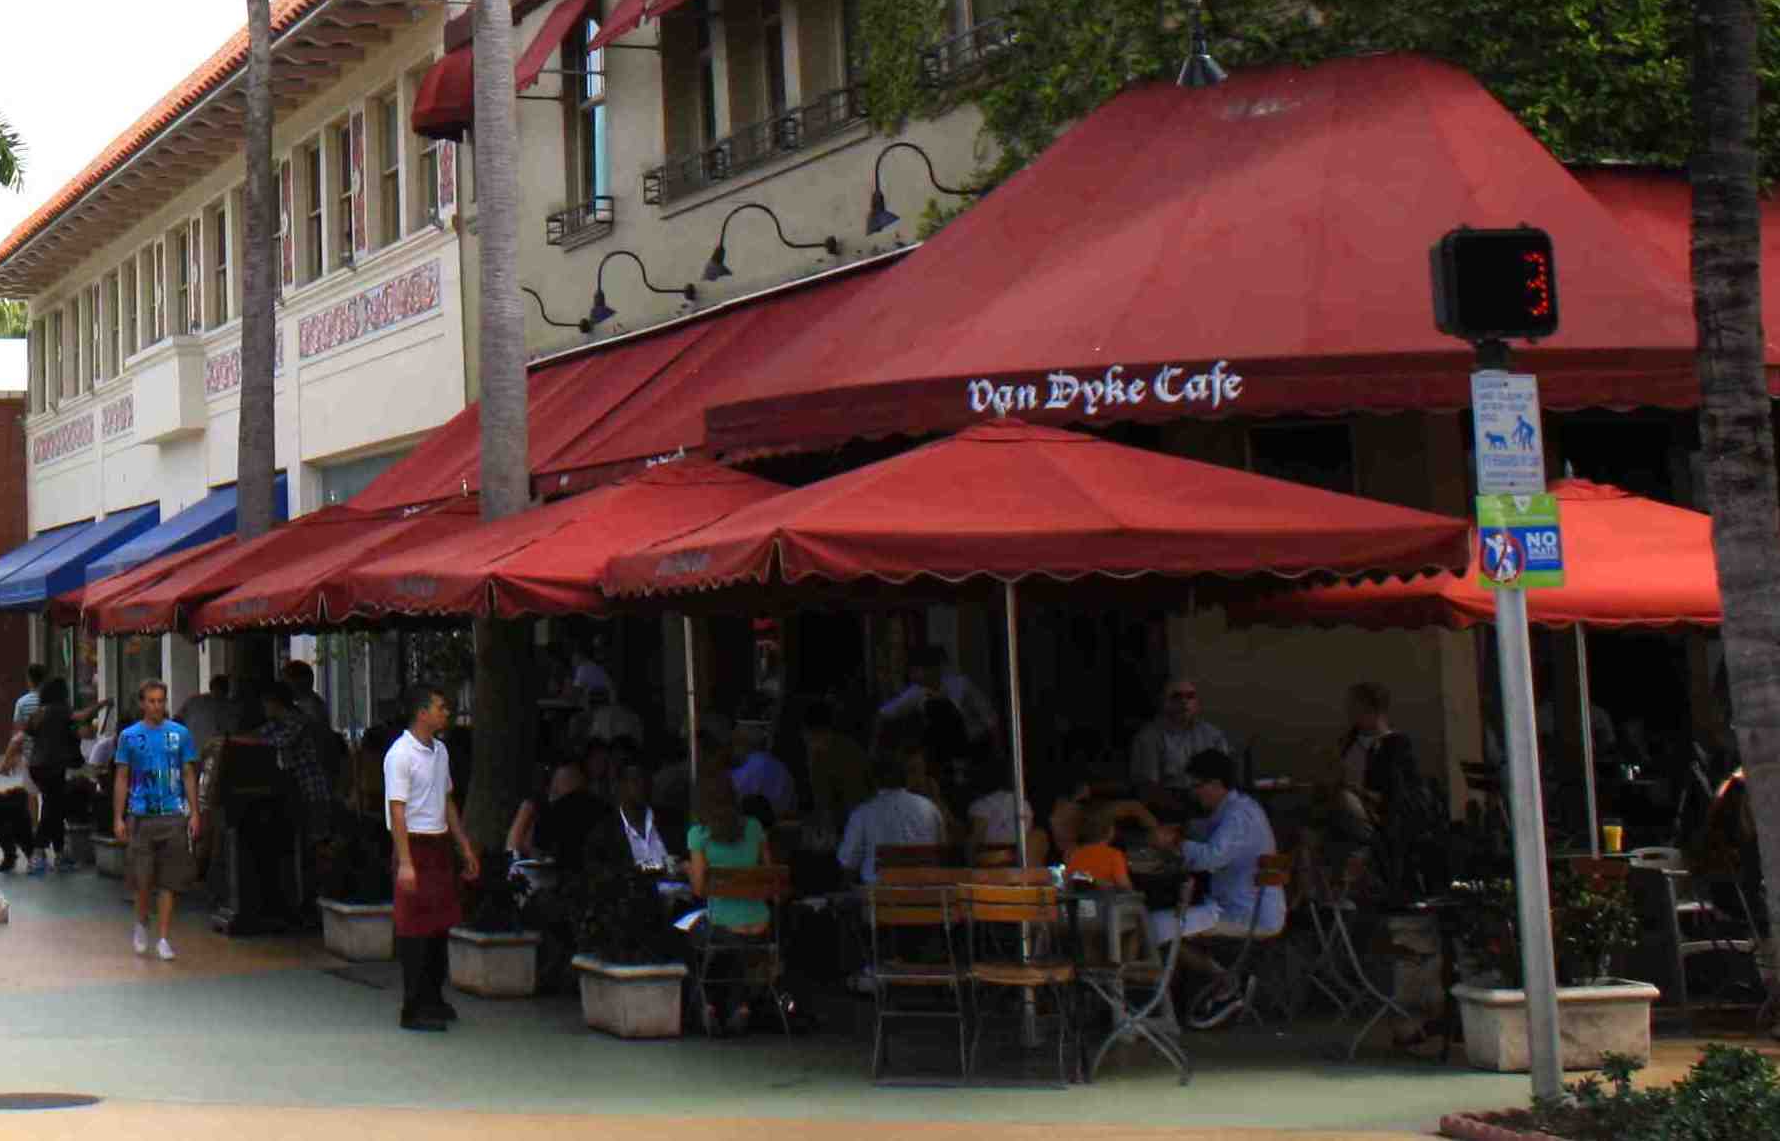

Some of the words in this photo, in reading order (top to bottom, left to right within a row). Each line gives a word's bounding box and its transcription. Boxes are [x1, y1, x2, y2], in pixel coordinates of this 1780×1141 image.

[967, 377, 1037, 413] Van
[1044, 364, 1147, 415] Dyke
[1152, 359, 1244, 409] Cafe
[1525, 530, 1557, 547] NO
